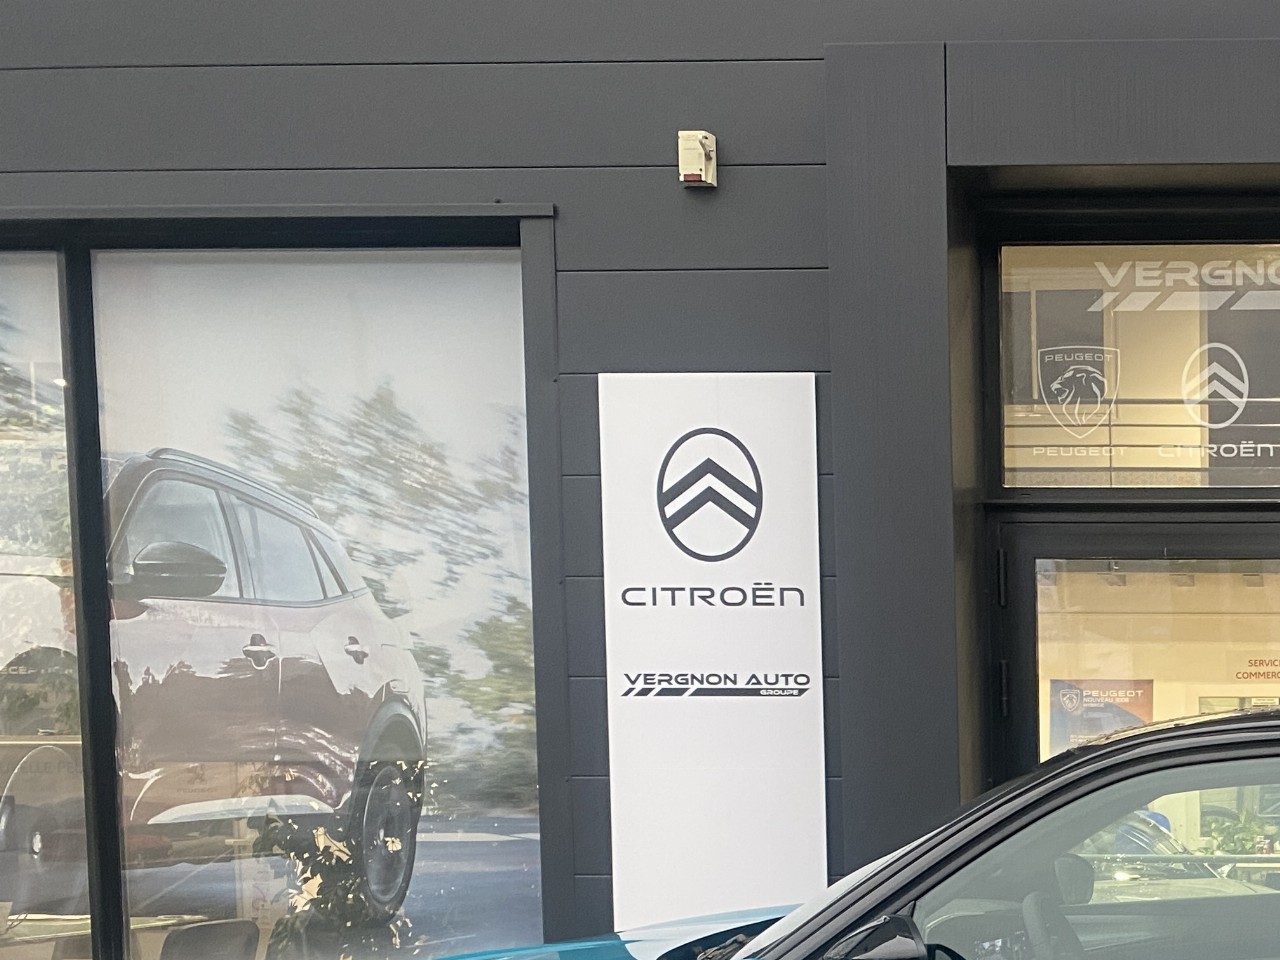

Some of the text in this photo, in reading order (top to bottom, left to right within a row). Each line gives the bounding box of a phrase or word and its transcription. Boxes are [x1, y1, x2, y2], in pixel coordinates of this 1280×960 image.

[1045, 353, 1113, 362] PEUGEOT
[1033, 447, 1128, 456] PEUGEOT
[1157, 441, 1274, 457] CITROËN
[621, 582, 806, 607] CITROËN
[623, 673, 811, 686] VERGNON AUTO
